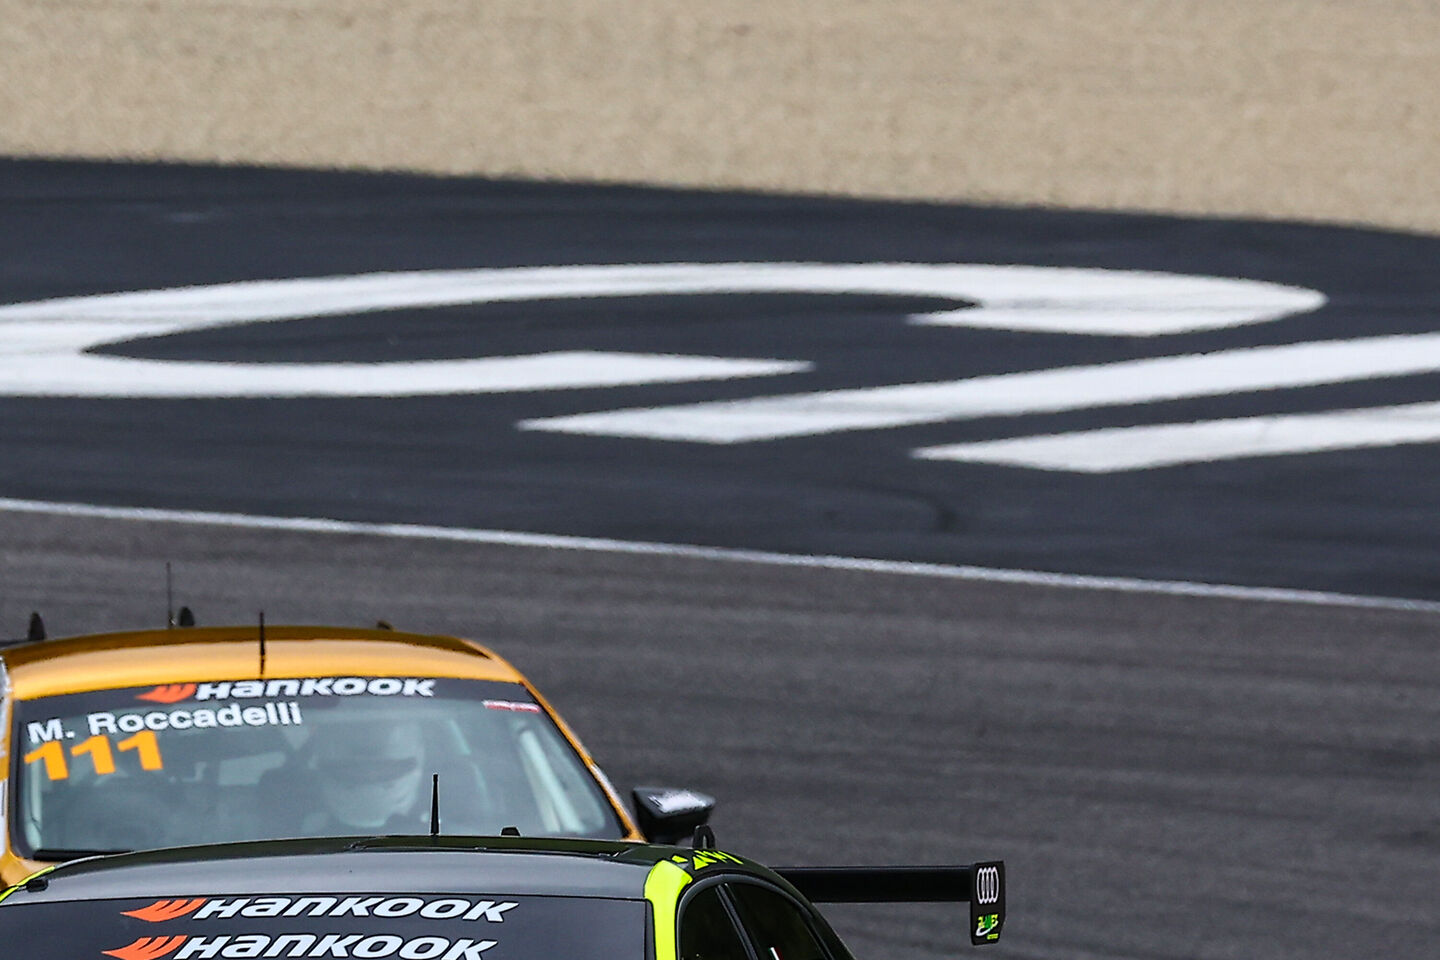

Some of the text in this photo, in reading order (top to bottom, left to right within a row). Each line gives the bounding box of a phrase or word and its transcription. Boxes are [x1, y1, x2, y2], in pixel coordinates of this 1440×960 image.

[27, 701, 303, 744] M. Roccadelli
[24, 730, 163, 781] 111
